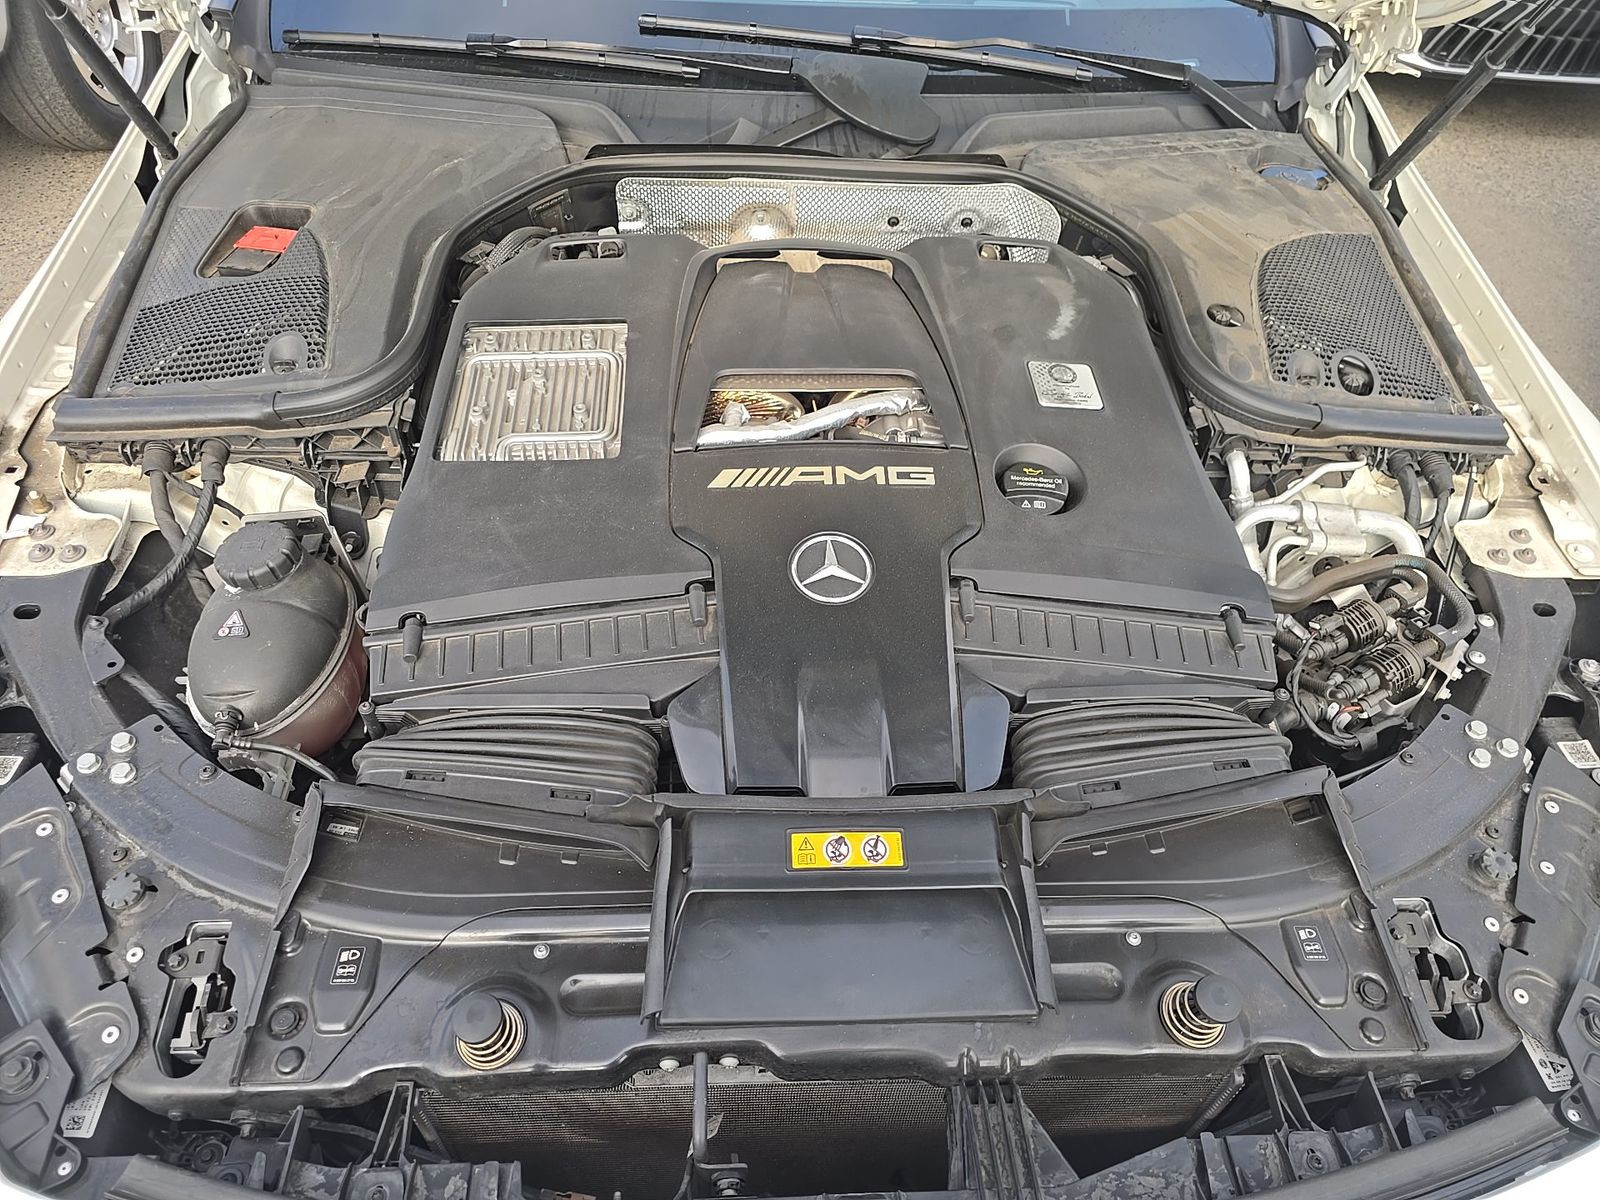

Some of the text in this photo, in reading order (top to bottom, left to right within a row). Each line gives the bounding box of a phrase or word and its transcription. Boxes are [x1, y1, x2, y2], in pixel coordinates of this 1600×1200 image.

[780, 466, 936, 487] AMG
[1010, 475, 1053, 484] Mercedes-Benz
[1016, 481, 1056, 489] recommended
